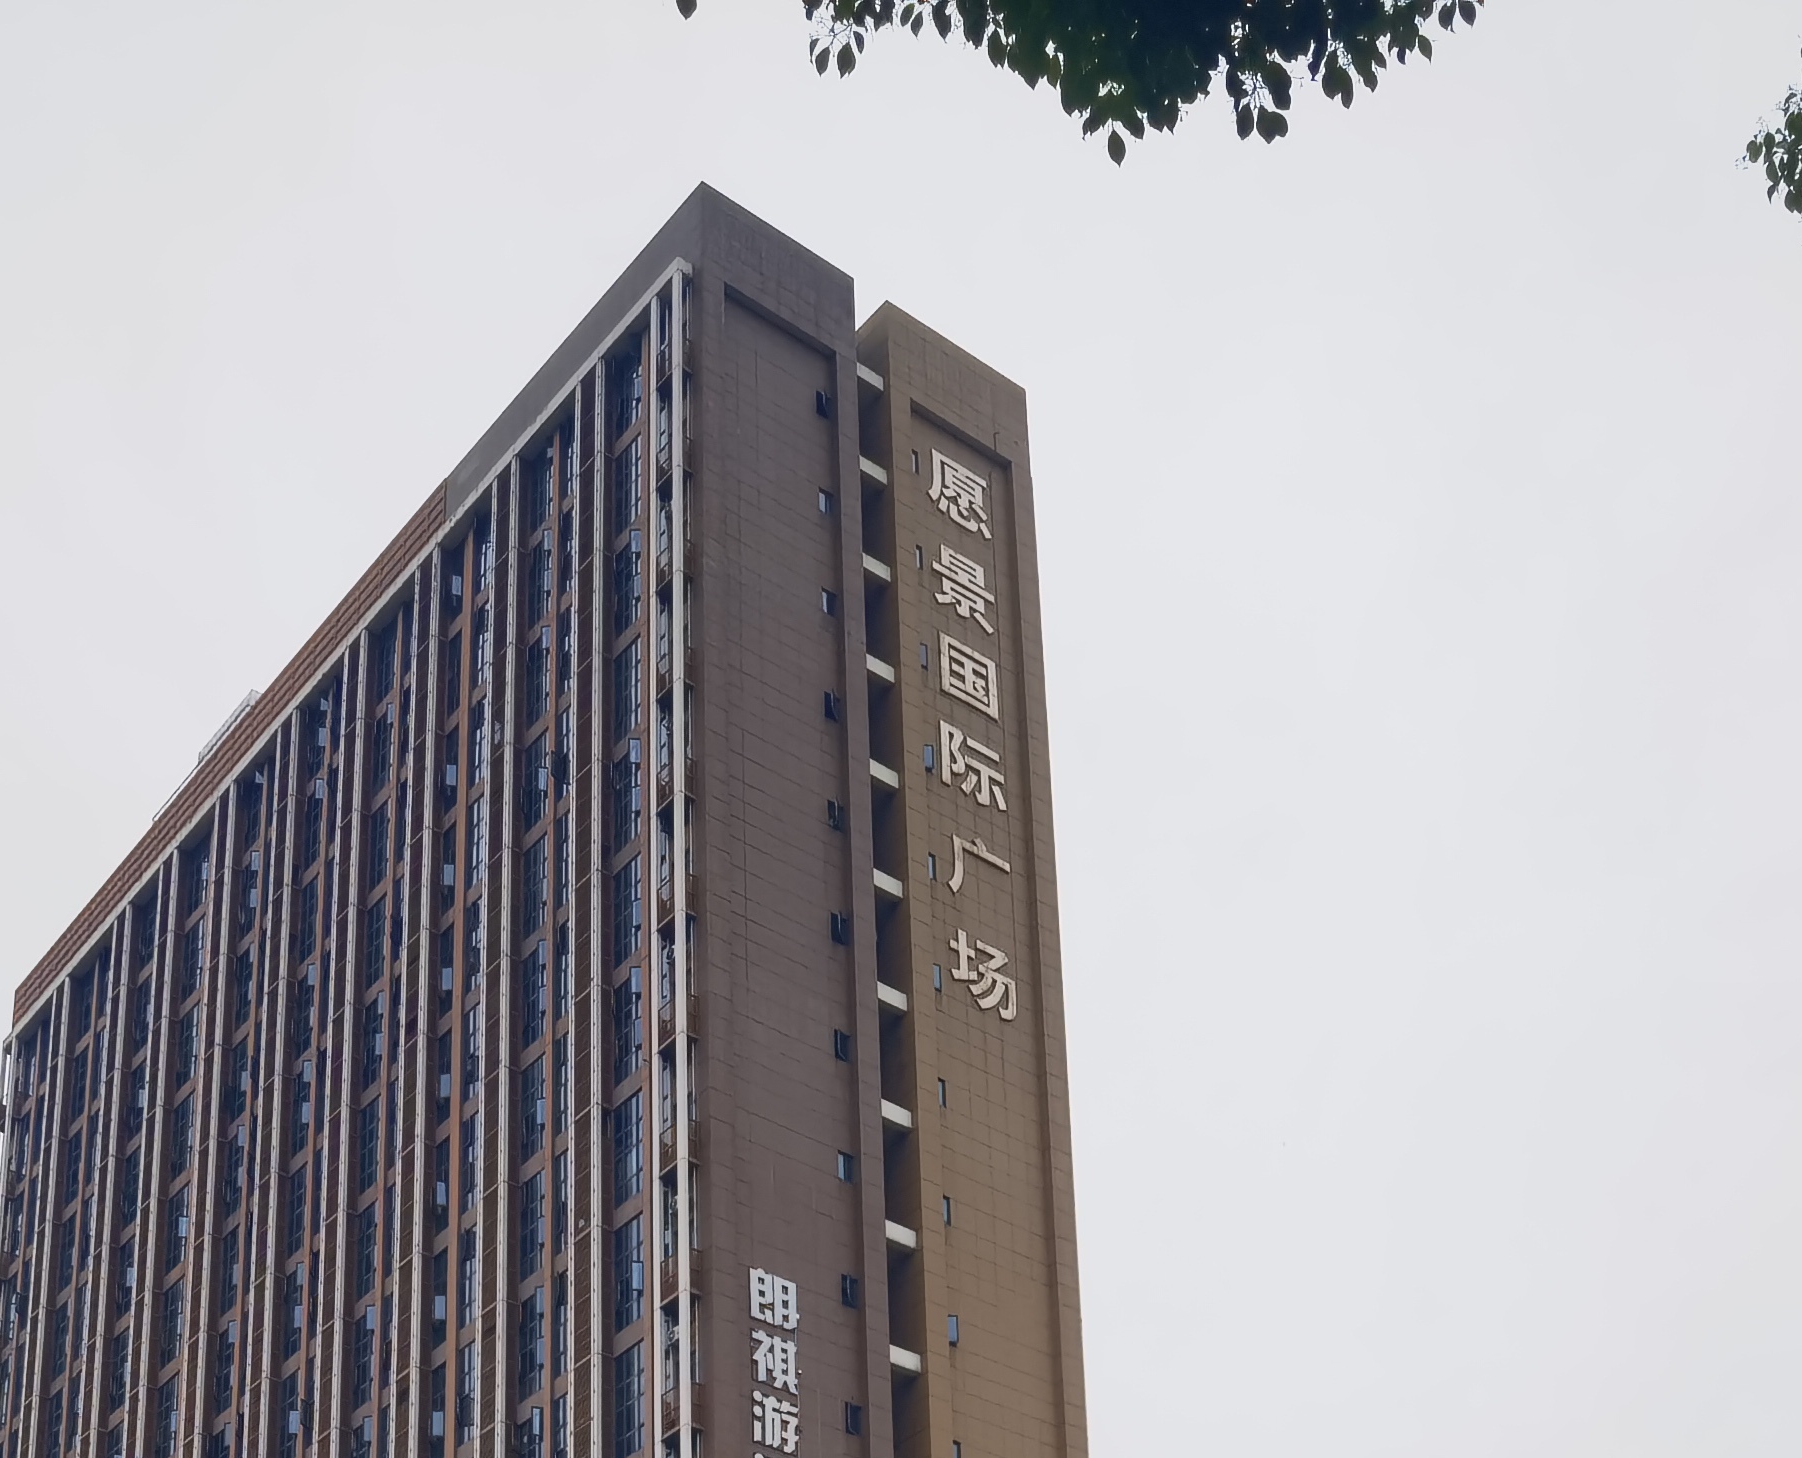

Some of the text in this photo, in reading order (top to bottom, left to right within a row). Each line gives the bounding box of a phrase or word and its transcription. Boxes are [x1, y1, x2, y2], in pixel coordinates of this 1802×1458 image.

[927, 448, 1018, 1021] 愿景国际广场
